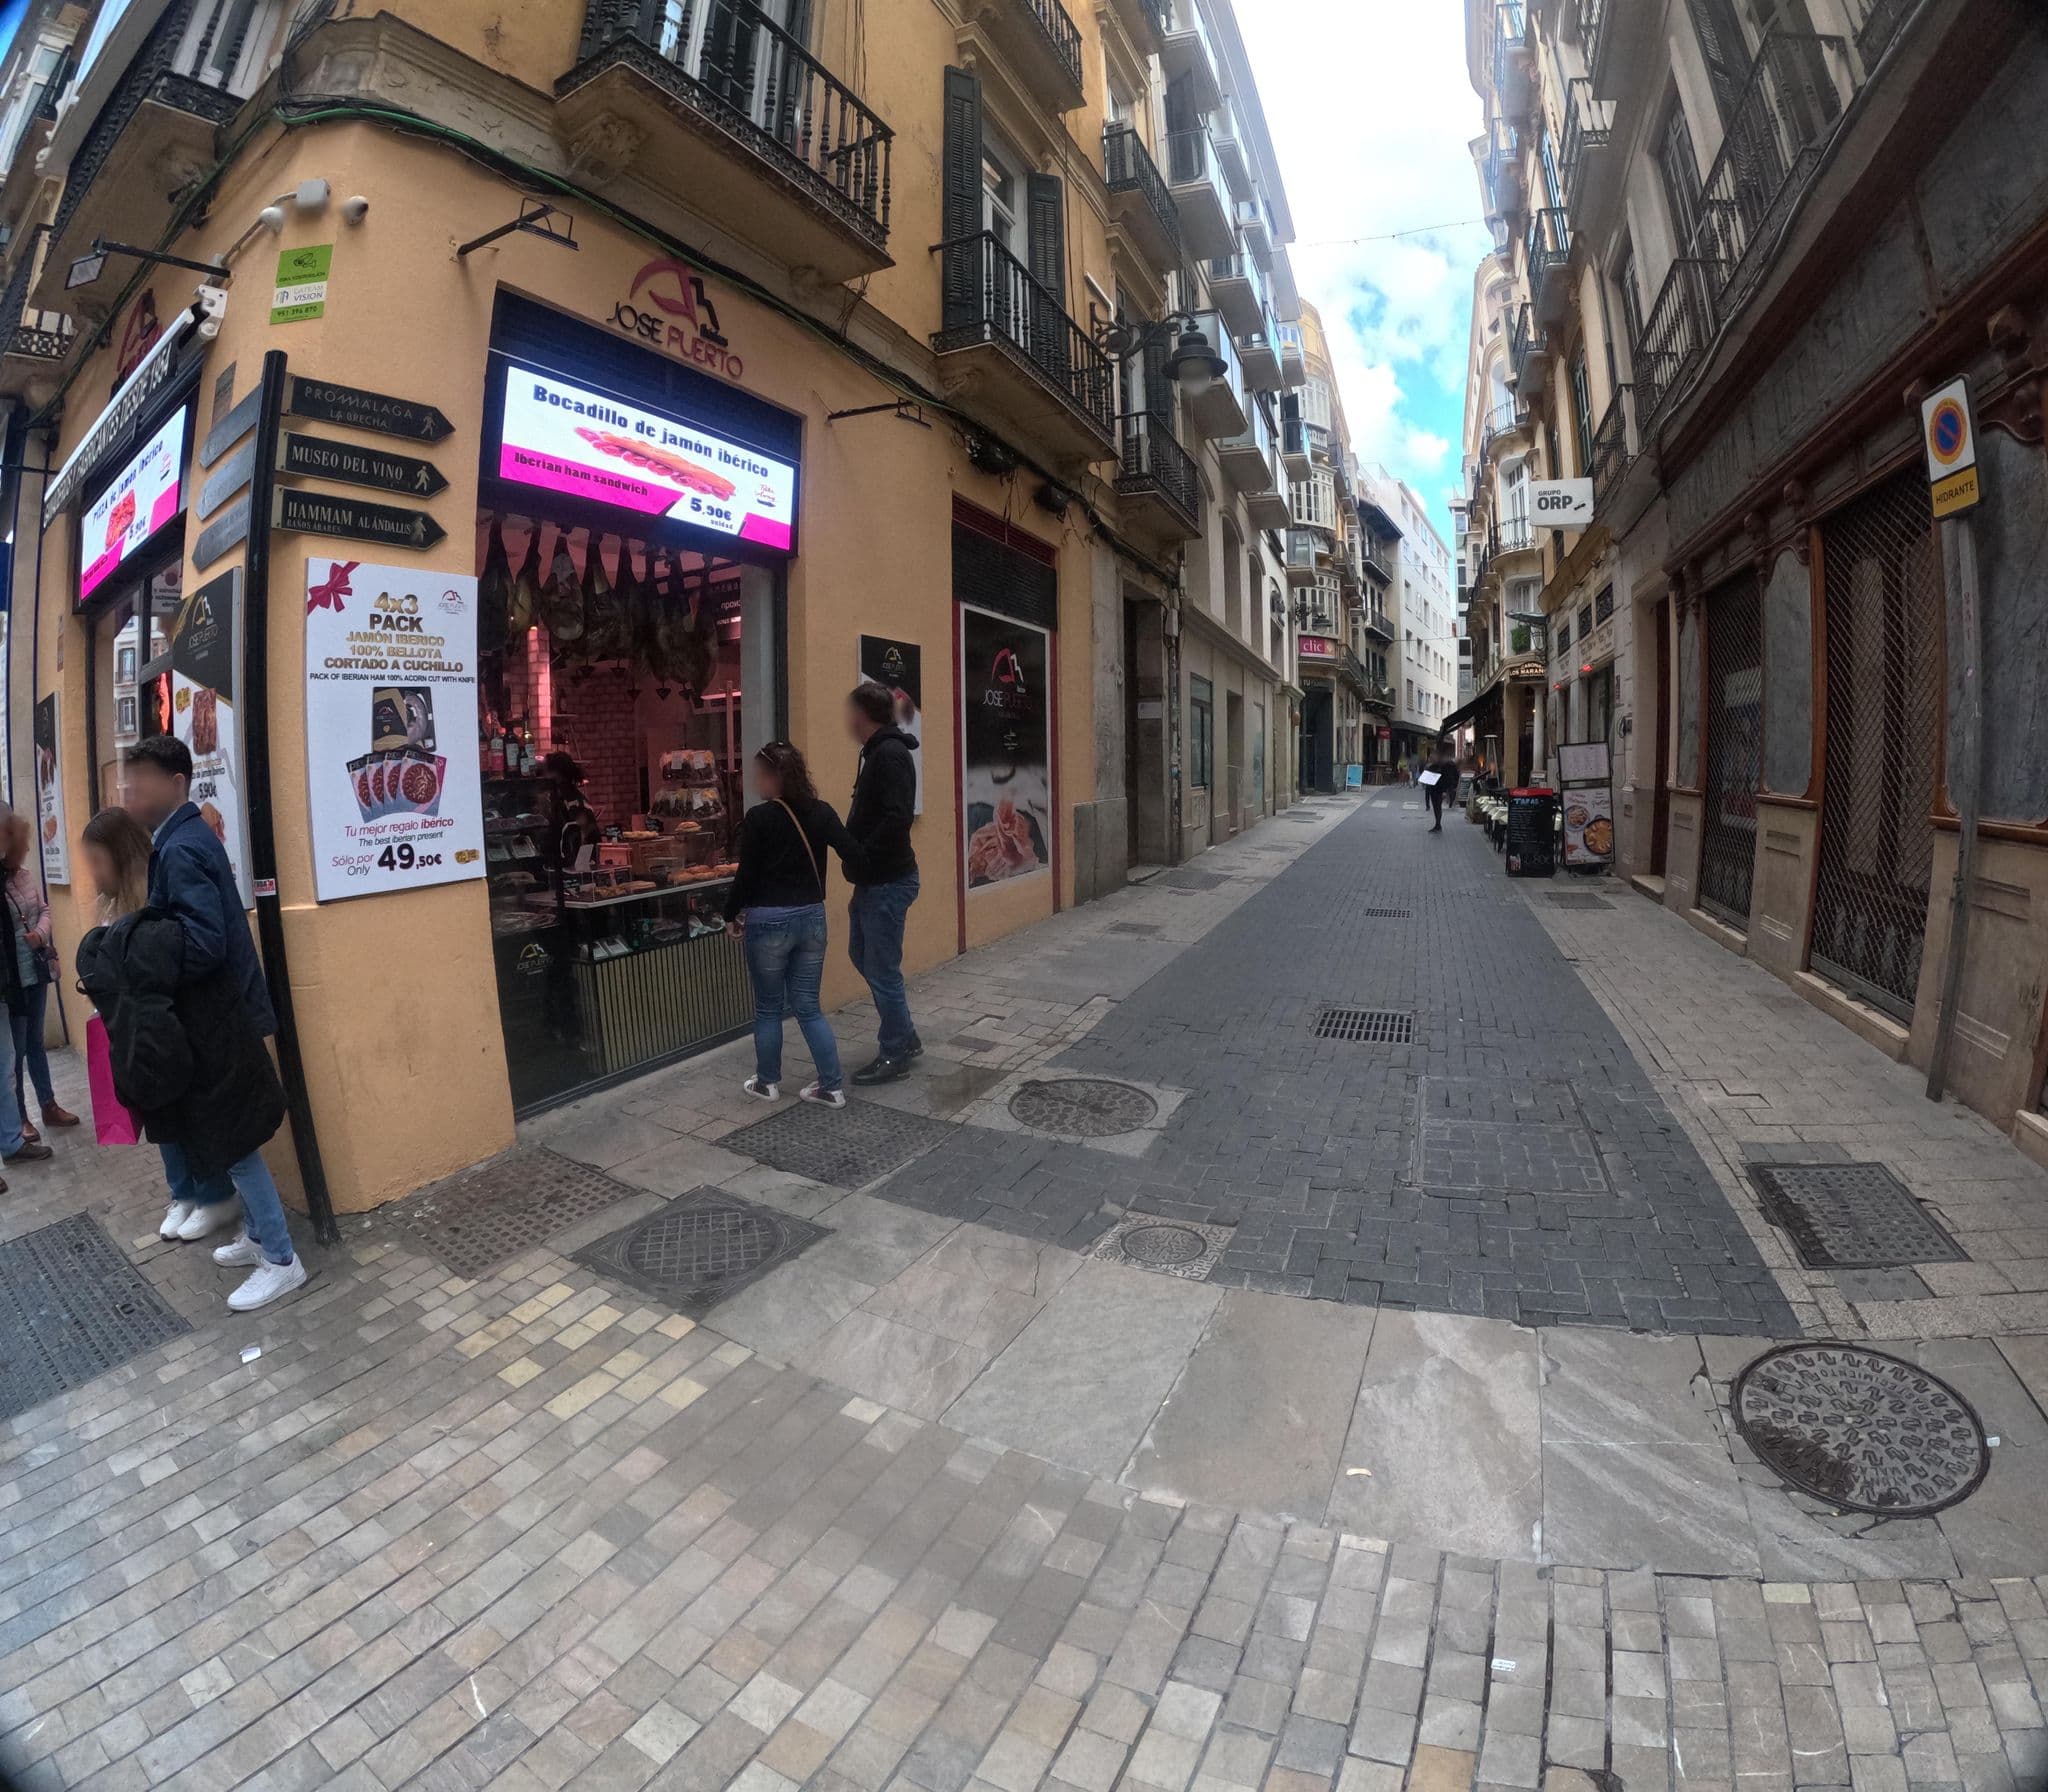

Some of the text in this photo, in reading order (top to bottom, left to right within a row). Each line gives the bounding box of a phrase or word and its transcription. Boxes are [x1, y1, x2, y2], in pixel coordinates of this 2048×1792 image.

[294, 292, 323, 302] VISION
[606, 301, 743, 378] JOSE PUERTO
[330, 409, 388, 429] LA BRECHA
[533, 384, 769, 478] Bocadillo de jamón ibérico
[292, 445, 403, 481] MUSEO DEL VINO
[514, 452, 648, 497] Iberian ham sandwich
[1936, 479, 1975, 505] HIDRANTE
[1537, 495, 1573, 511] ORP
[288, 501, 353, 526] HAMMAM
[358, 516, 371, 529] AL
[374, 591, 419, 615] 4x3
[369, 613, 423, 633] PACK
[346, 630, 445, 647] JAMÓN IBERICO
[1303, 640, 1323, 653] clic
[350, 645, 442, 659] 100% BELLOTA
[324, 657, 463, 673] CORTADO A CUCHILLO
[309, 672, 329, 681] PACK
[330, 673, 340, 681] OF
[370, 674, 386, 682] HAM
[983, 690, 1003, 707] JOSE
[344, 817, 454, 838] Tu mejor regalo ibérico
[358, 838, 373, 847] The
[375, 836, 390, 846] best
[417, 831, 444, 842] present
[332, 853, 374, 867] Sólo por
[347, 864, 371, 877] Only
